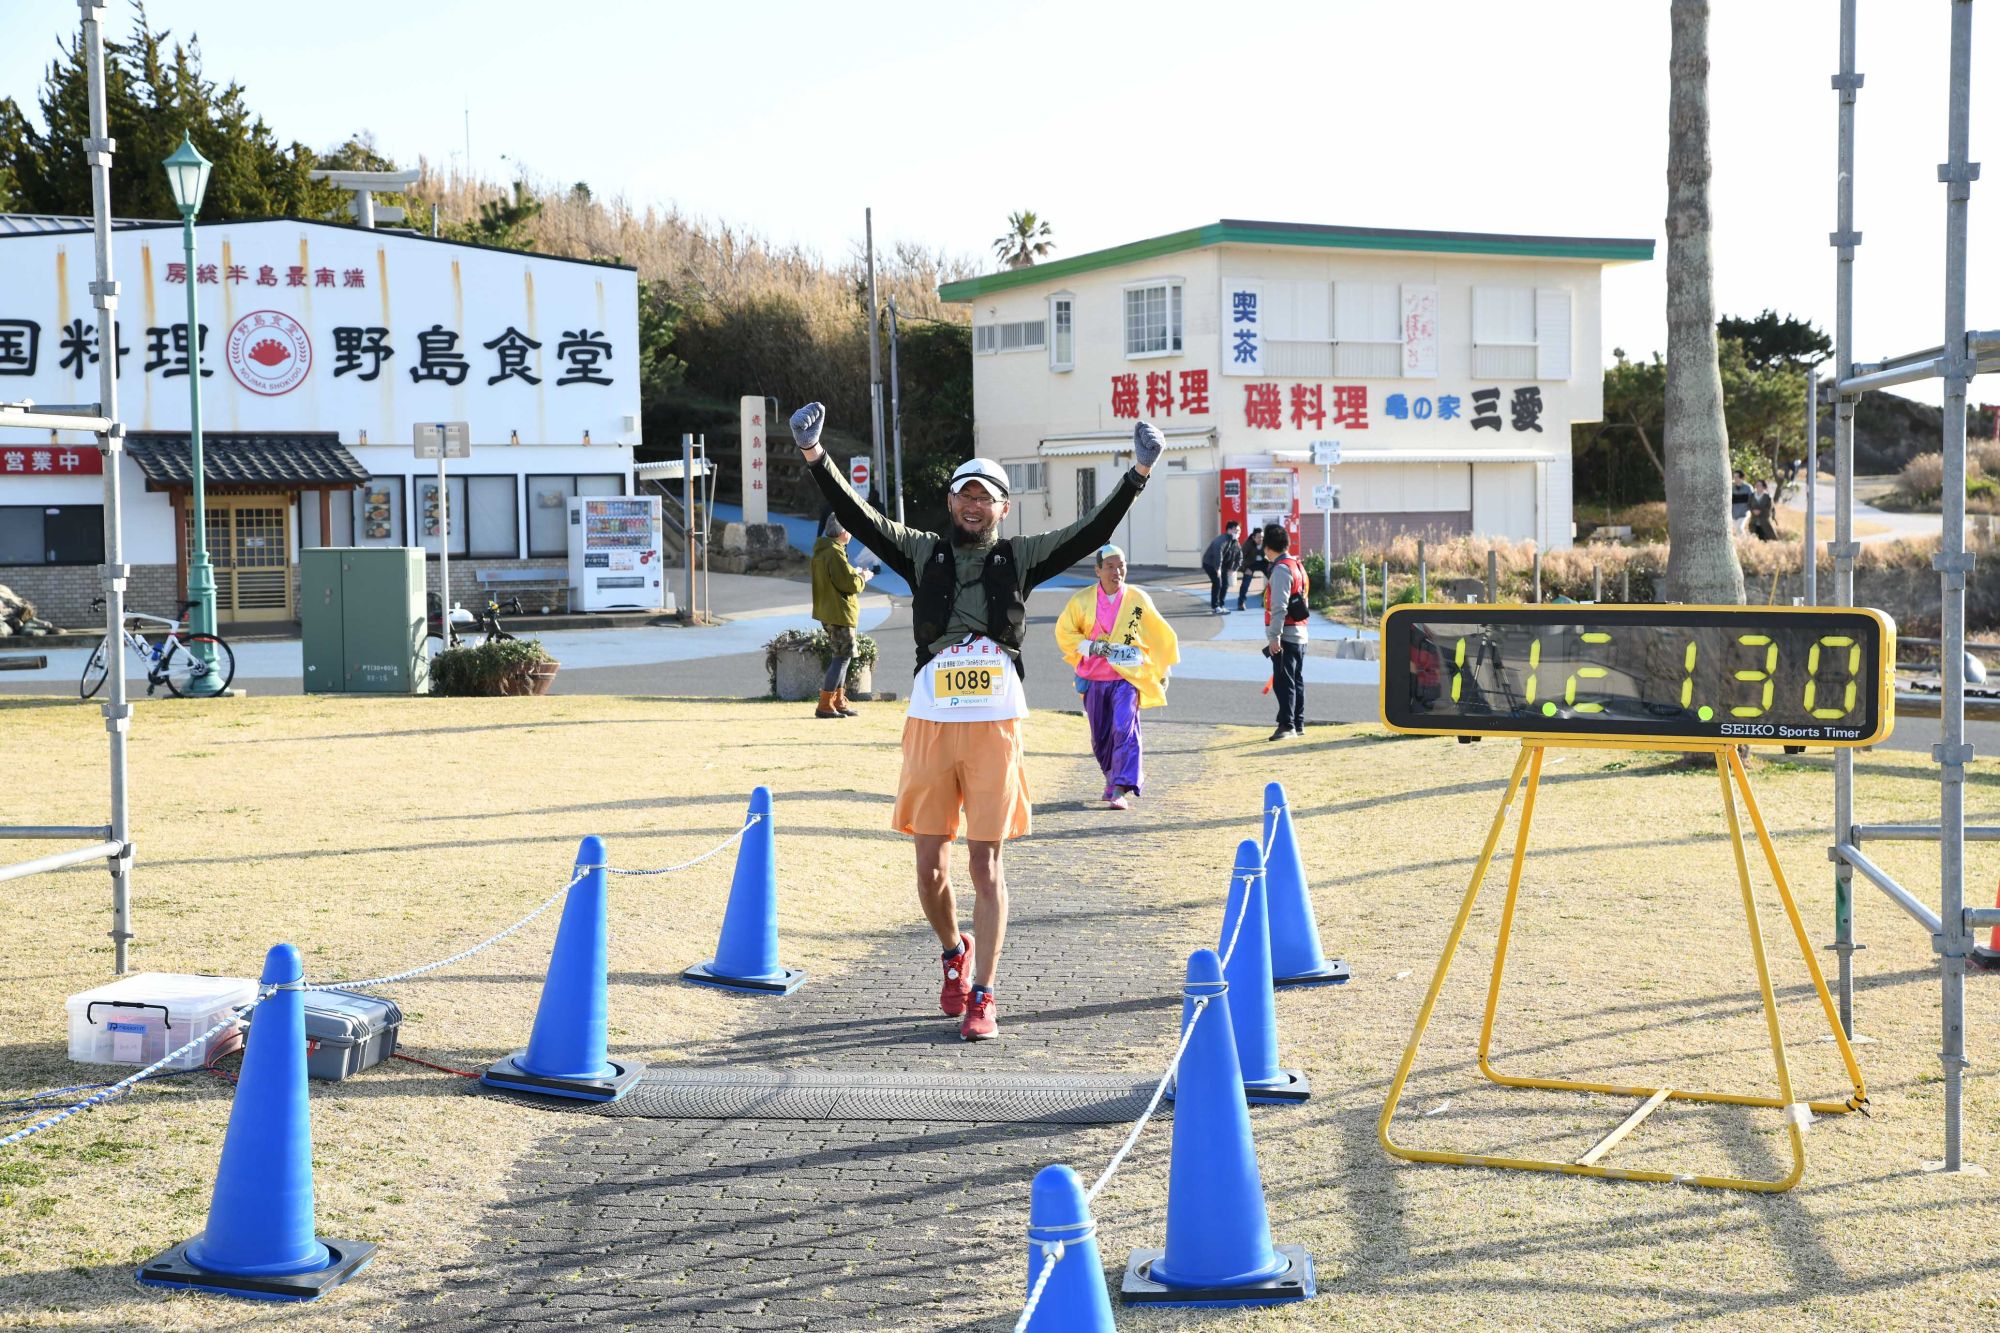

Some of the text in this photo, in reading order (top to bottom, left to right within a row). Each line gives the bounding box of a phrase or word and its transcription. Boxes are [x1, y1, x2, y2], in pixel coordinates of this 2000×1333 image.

[165, 262, 365, 289] 房総半島最南端
[1232, 290, 1258, 363] 喫茶
[332, 324, 614, 386] 野島食堂
[1111, 369, 1209, 419] 磯料理
[1243, 383, 1544, 433] 磯料理 亀の家 三愛
[4, 451, 80, 472] 営業中
[945, 670, 990, 691] 1089
[1720, 723, 1861, 738] SEIKO Sports Timer
